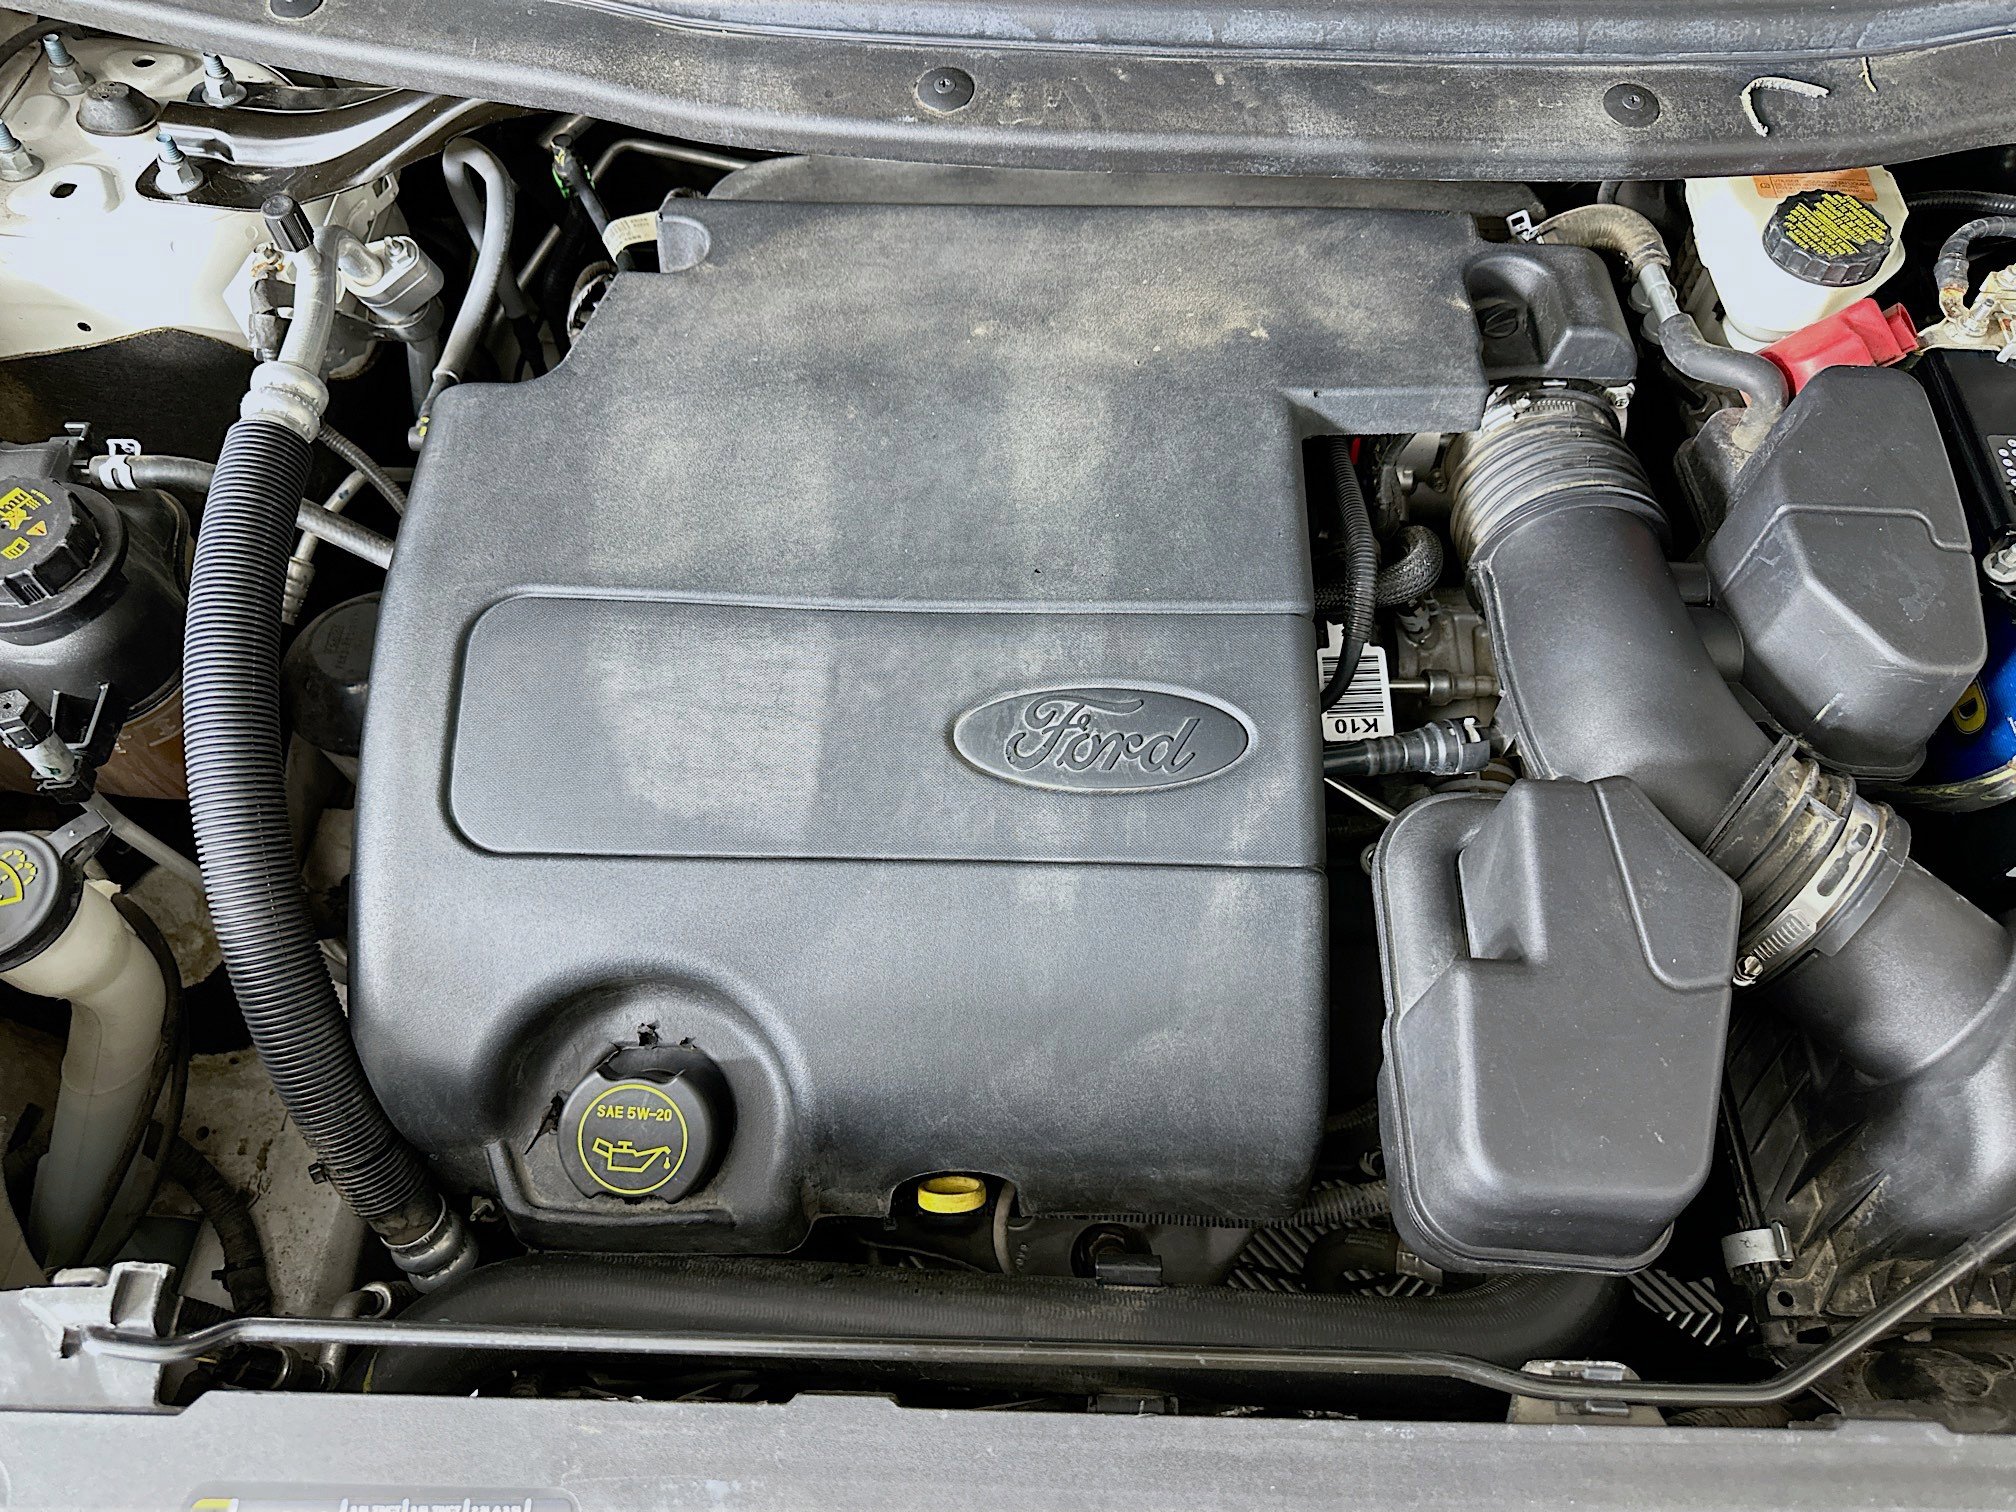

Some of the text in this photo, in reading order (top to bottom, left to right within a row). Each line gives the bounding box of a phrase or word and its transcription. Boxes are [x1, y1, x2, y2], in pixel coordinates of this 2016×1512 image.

[1004, 695, 1200, 774] Ford
[1334, 717, 1379, 734] K10
[597, 1104, 673, 1122] SAE 5W-20
